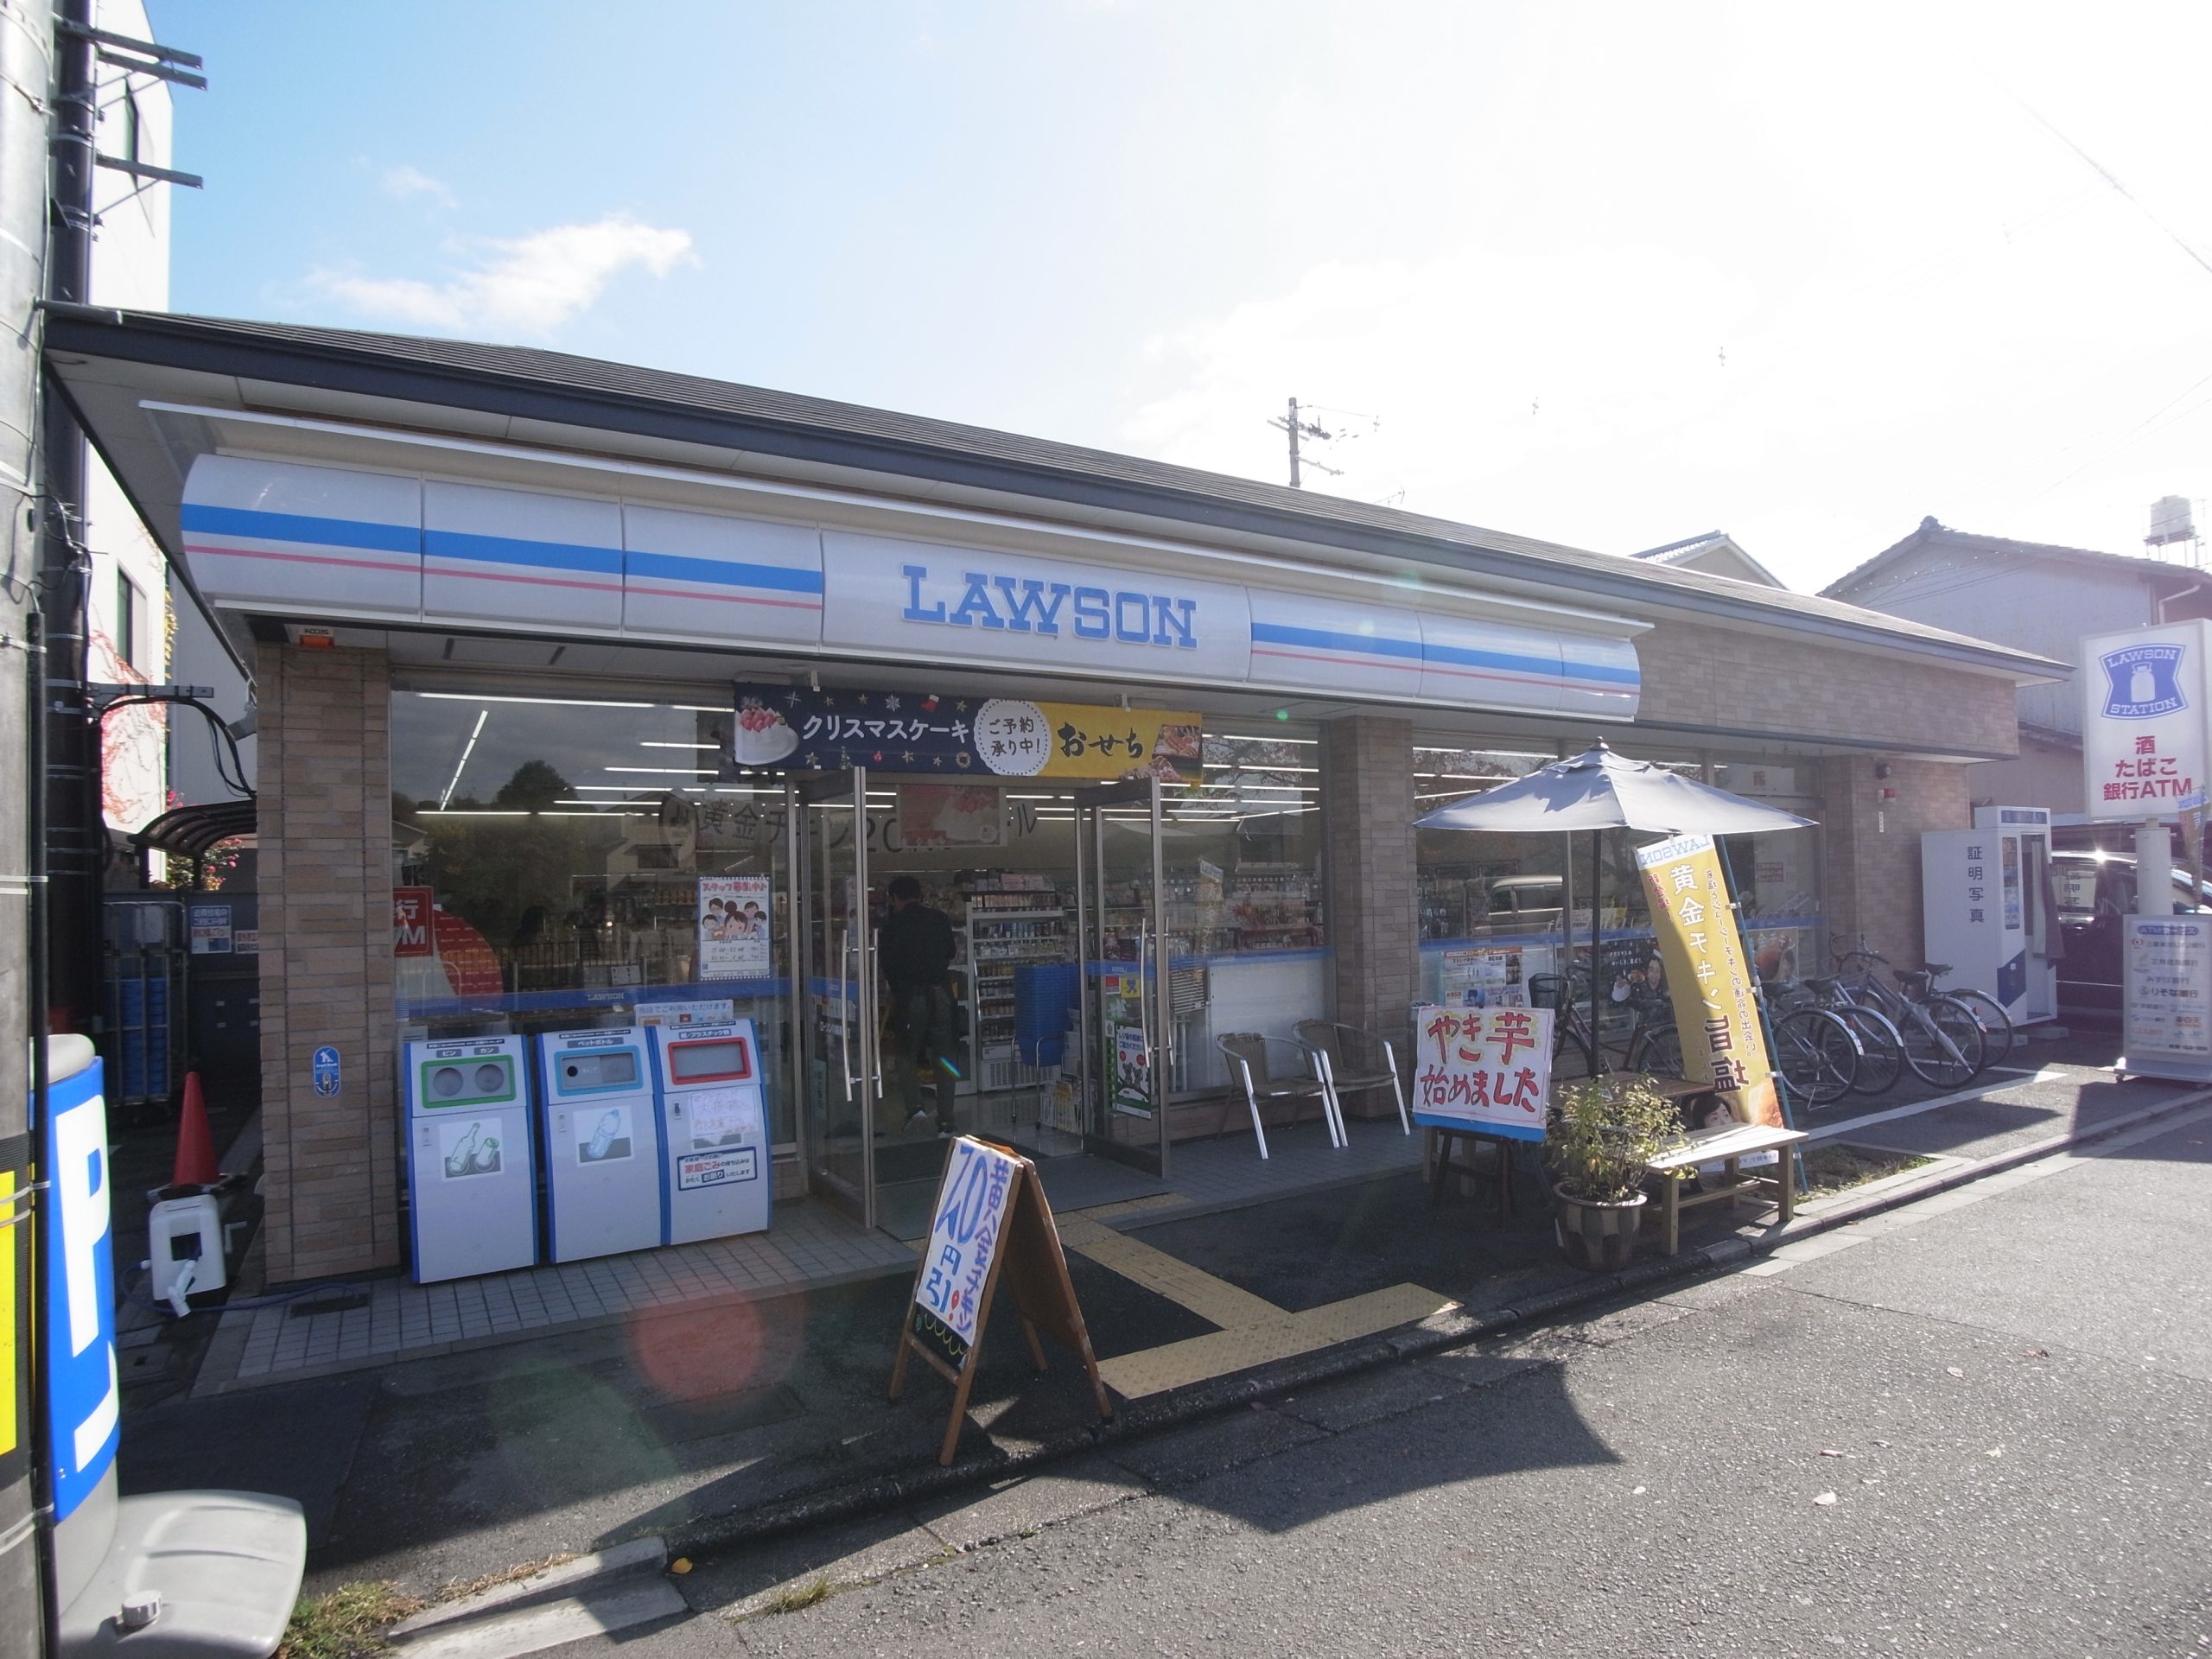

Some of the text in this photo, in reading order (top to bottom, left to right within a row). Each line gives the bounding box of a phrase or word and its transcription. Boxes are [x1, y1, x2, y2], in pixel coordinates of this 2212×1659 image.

[901, 564, 1198, 649] LAWSON
[2107, 649, 2177, 668] LAWSON
[2110, 697, 2178, 715] STATION
[803, 715, 970, 744] クリスマスケーキ
[989, 716, 1034, 735] ご予約
[1057, 721, 1144, 757] おせち
[2135, 735, 2155, 754] 酒
[2115, 758, 2177, 778] たばこ
[2103, 778, 2192, 801] 銀行ATM
[1967, 846, 1985, 923] 証明写真
[576, 1038, 613, 1046] ペットボトル
[1427, 1012, 1535, 1065] やき芋
[1421, 1065, 1539, 1113] 始めました
[55, 1094, 111, 1358] P
